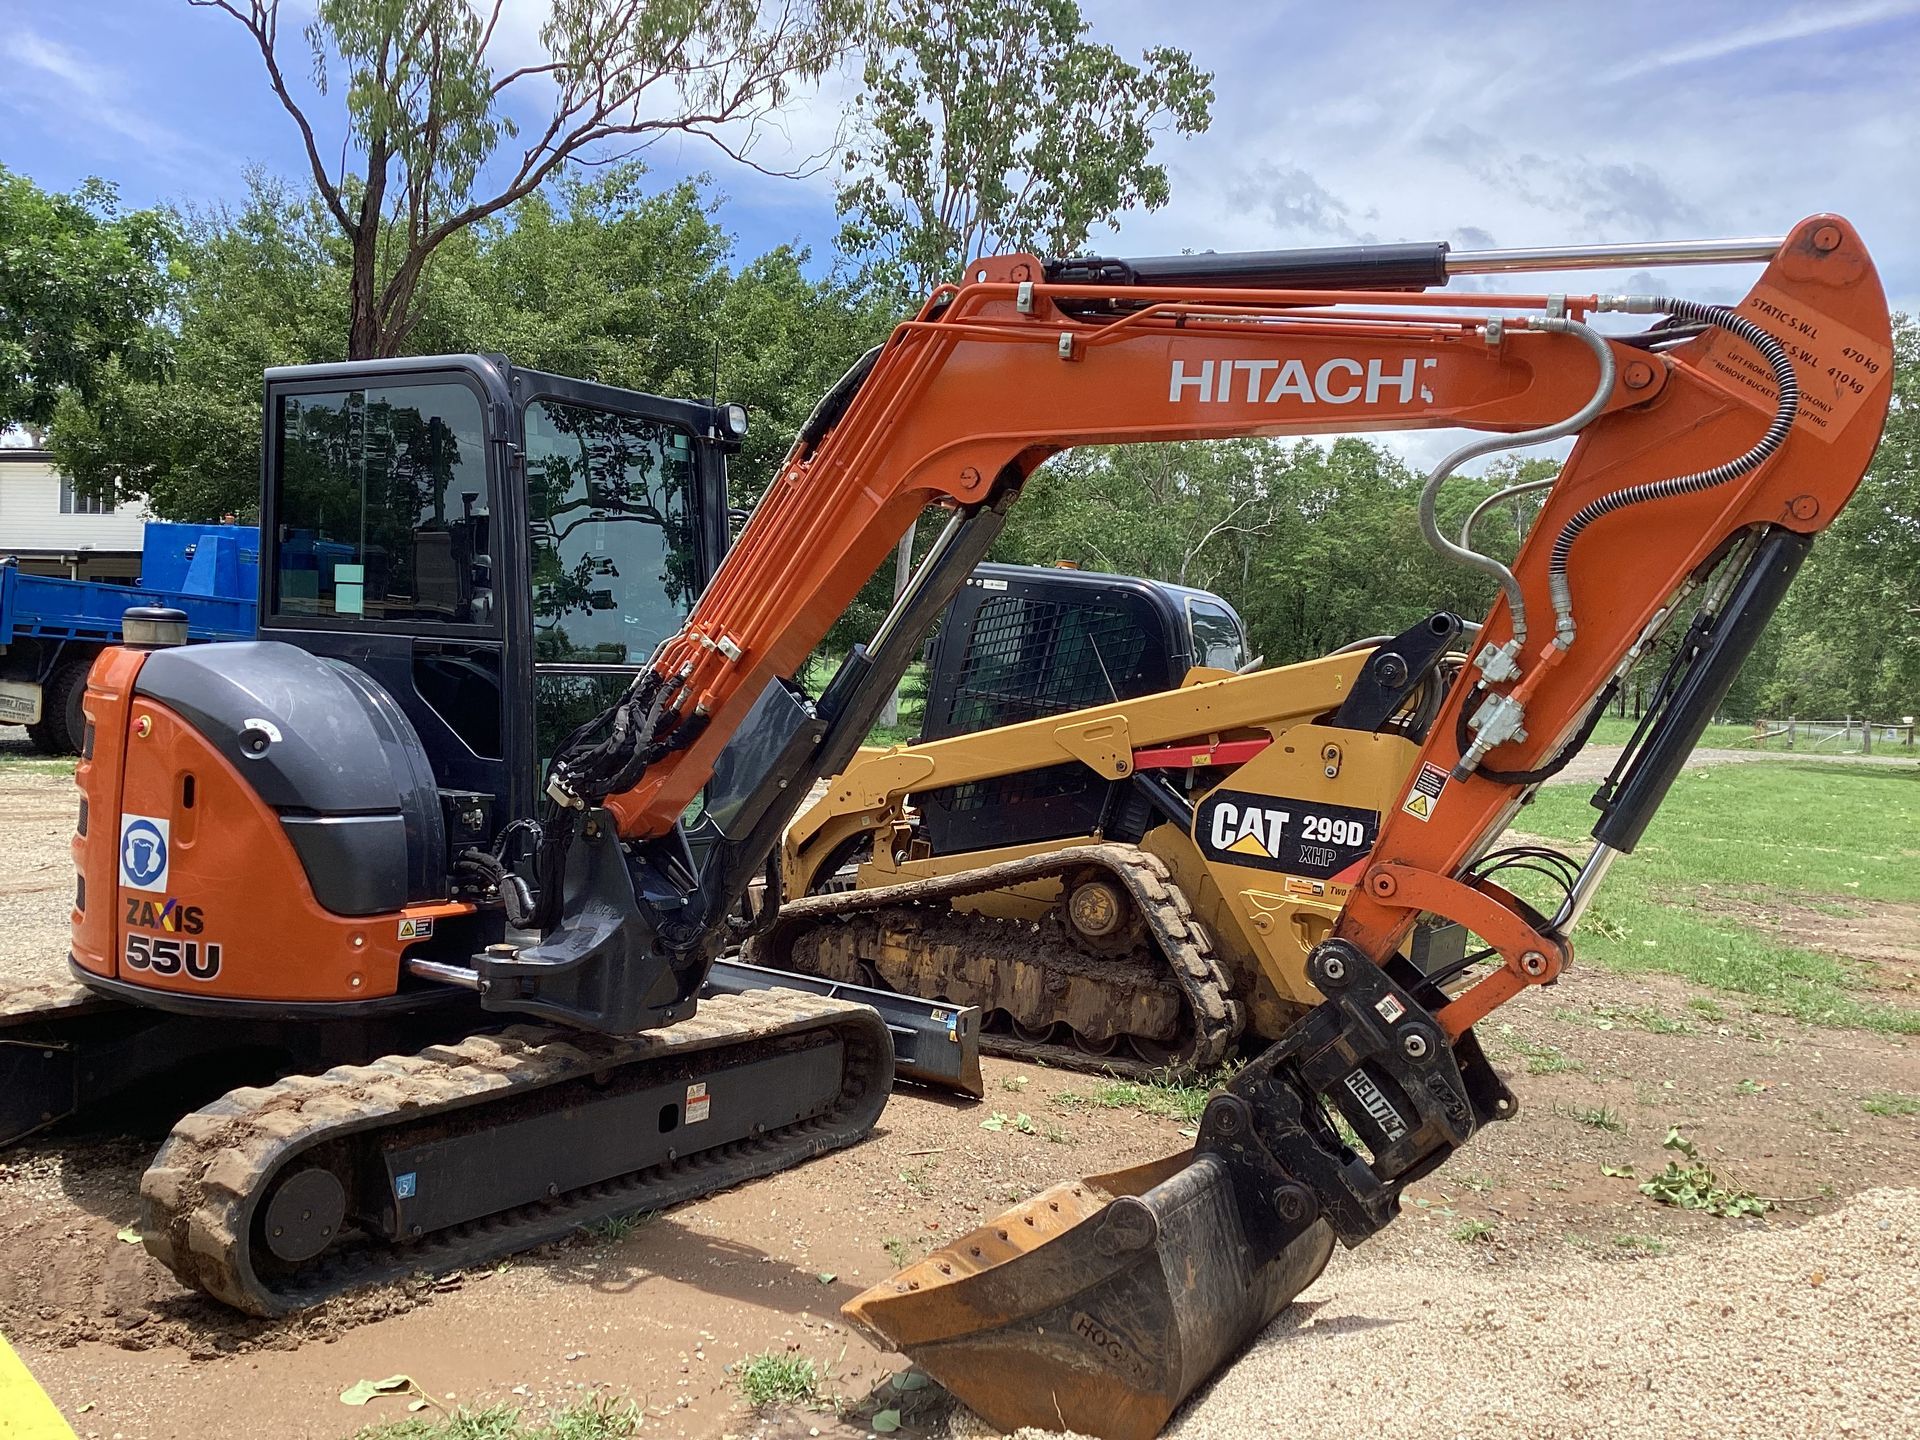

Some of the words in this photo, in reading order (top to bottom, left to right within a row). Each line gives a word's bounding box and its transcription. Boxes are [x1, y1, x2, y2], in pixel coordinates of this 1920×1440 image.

[1751, 298, 1790, 323] STATIC
[1842, 347, 1863, 364] 470
[1864, 356, 1880, 374] kg
[1727, 351, 1744, 367] LIFT
[1743, 360, 1766, 376] FROM
[1827, 367, 1848, 384] 410
[1849, 377, 1865, 394] kg
[1746, 378, 1777, 399] BUCKET
[1798, 408, 1828, 428] LIFTING
[1211, 802, 1290, 858] CAT
[1301, 815, 1364, 847] 299D
[1299, 845, 1337, 867] XHP
[126, 898, 204, 934] ZAXIS
[126, 933, 222, 981] 55U
